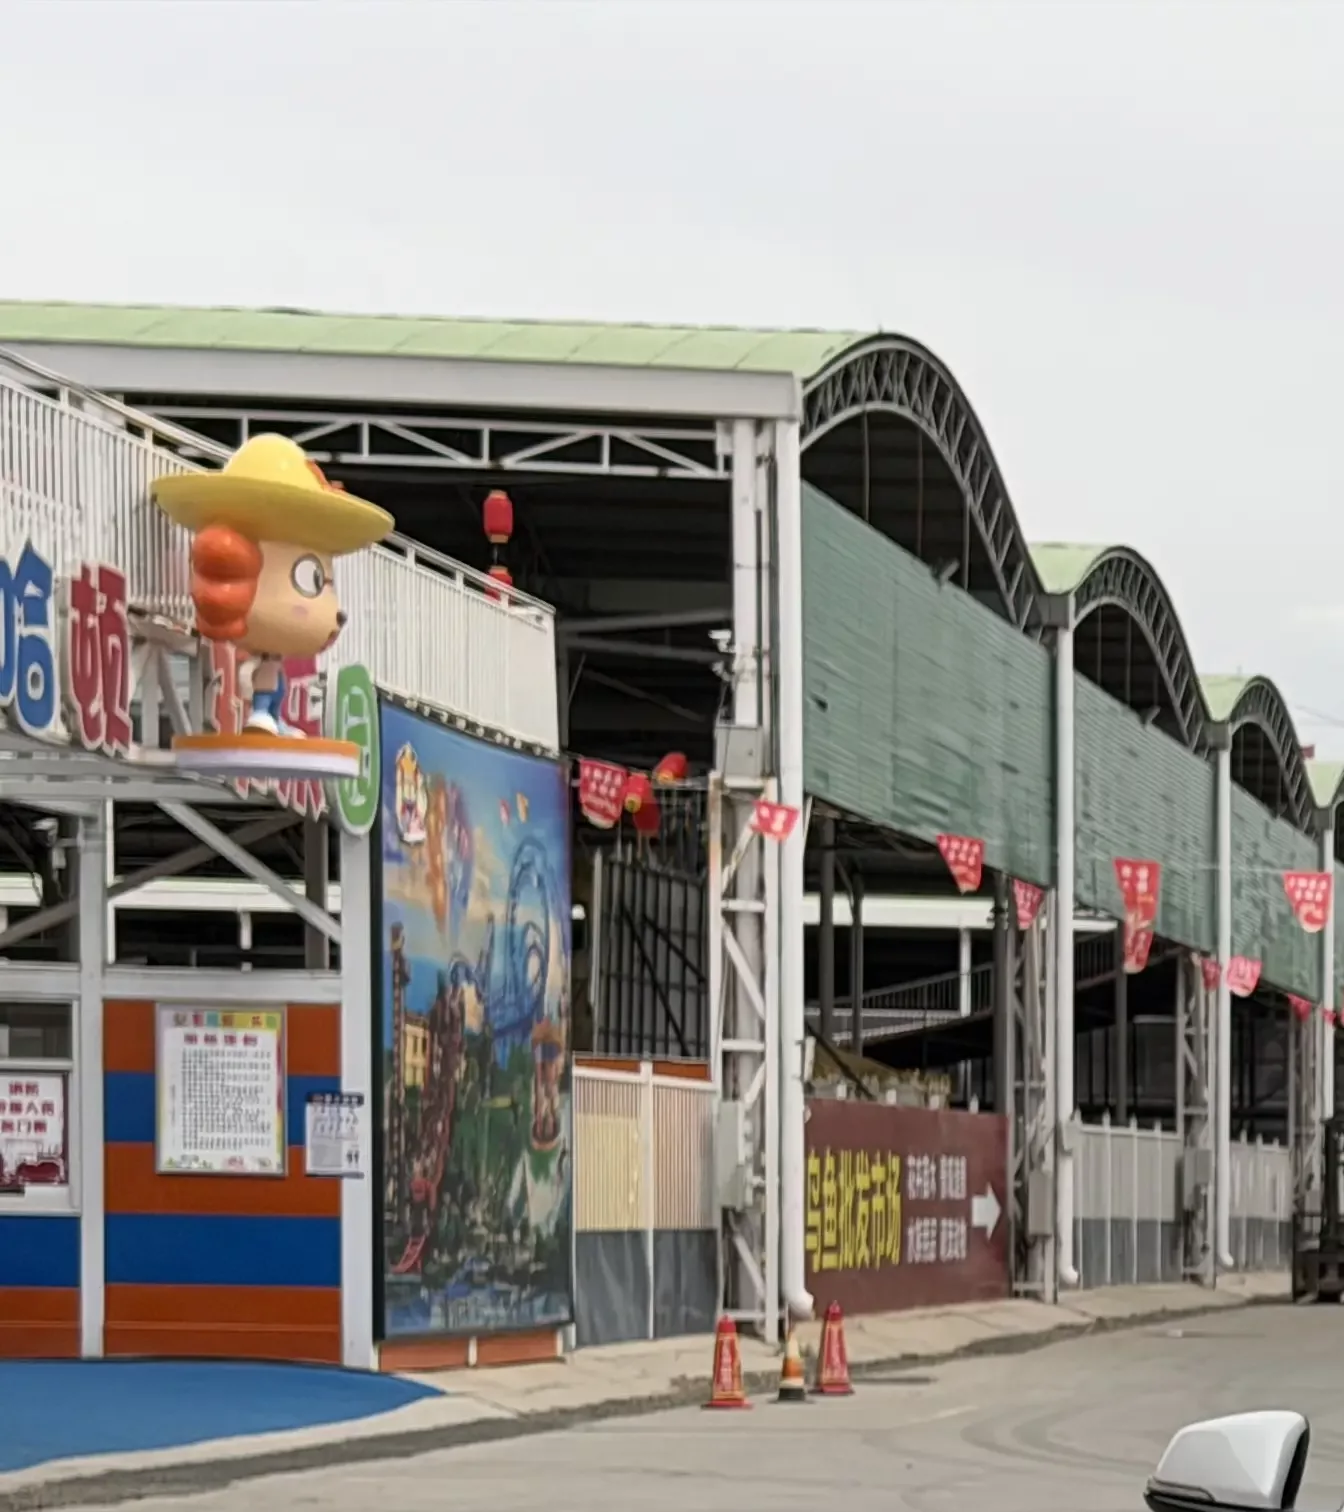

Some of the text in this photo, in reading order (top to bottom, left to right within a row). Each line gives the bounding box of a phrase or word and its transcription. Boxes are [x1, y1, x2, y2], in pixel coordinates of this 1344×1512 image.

[805, 1146, 901, 1273] 鸟鱼批发市场
